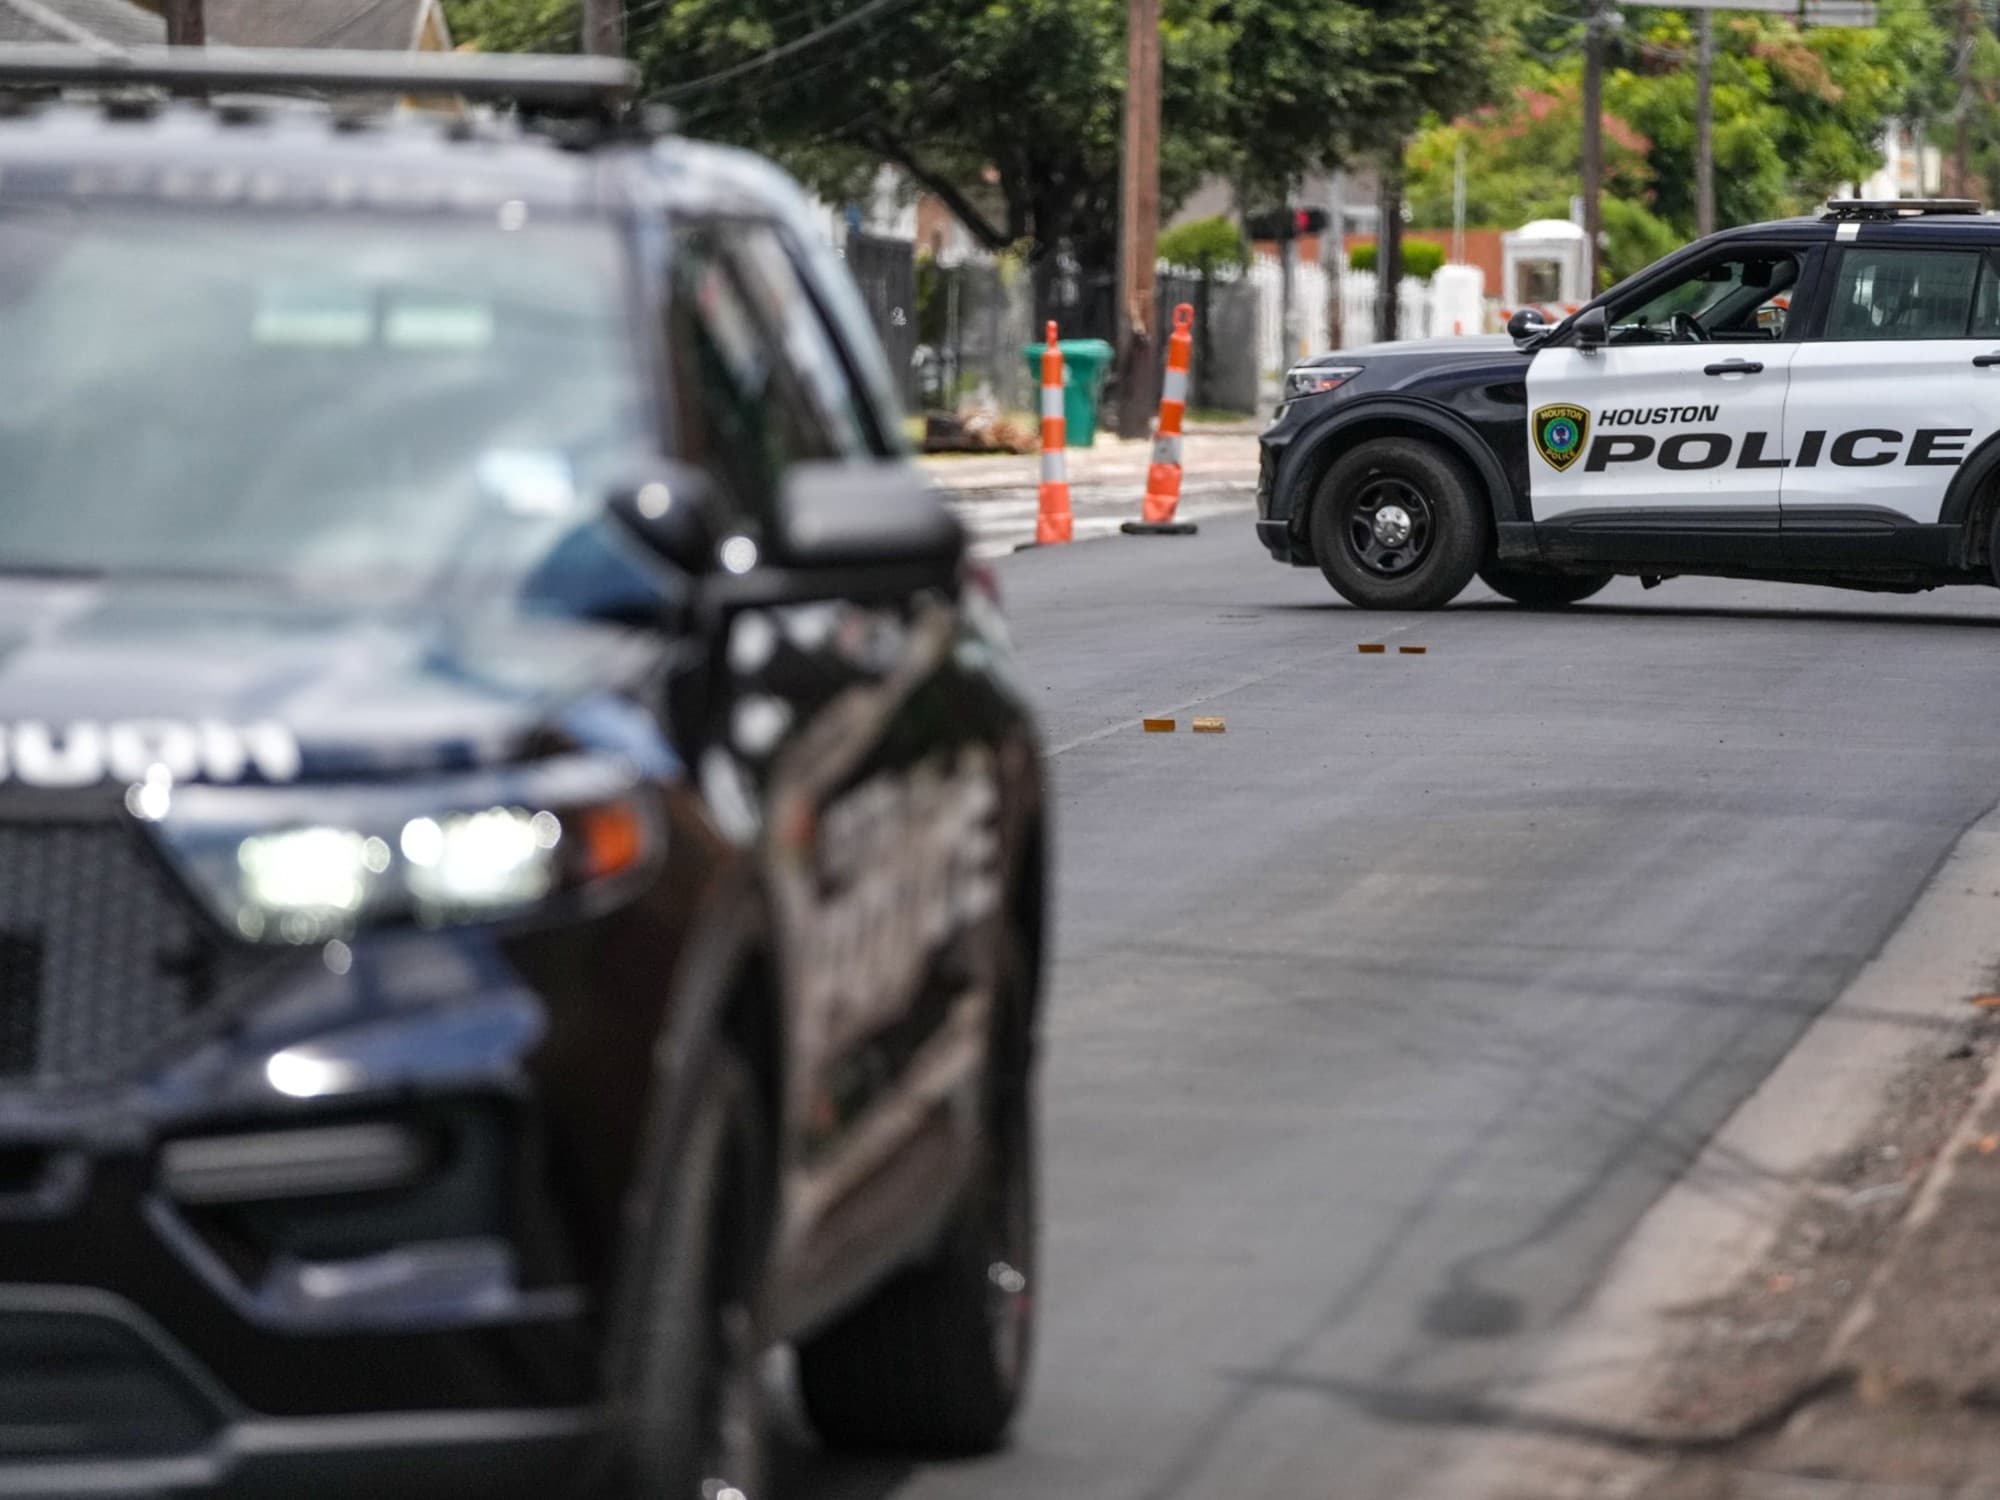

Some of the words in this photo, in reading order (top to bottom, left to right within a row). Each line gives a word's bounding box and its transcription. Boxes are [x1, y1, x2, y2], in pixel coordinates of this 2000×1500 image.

[1541, 408, 1584, 421] HOUSTON
[1598, 404, 1719, 426] HOUSTON
[1583, 428, 1973, 472] POLICE
